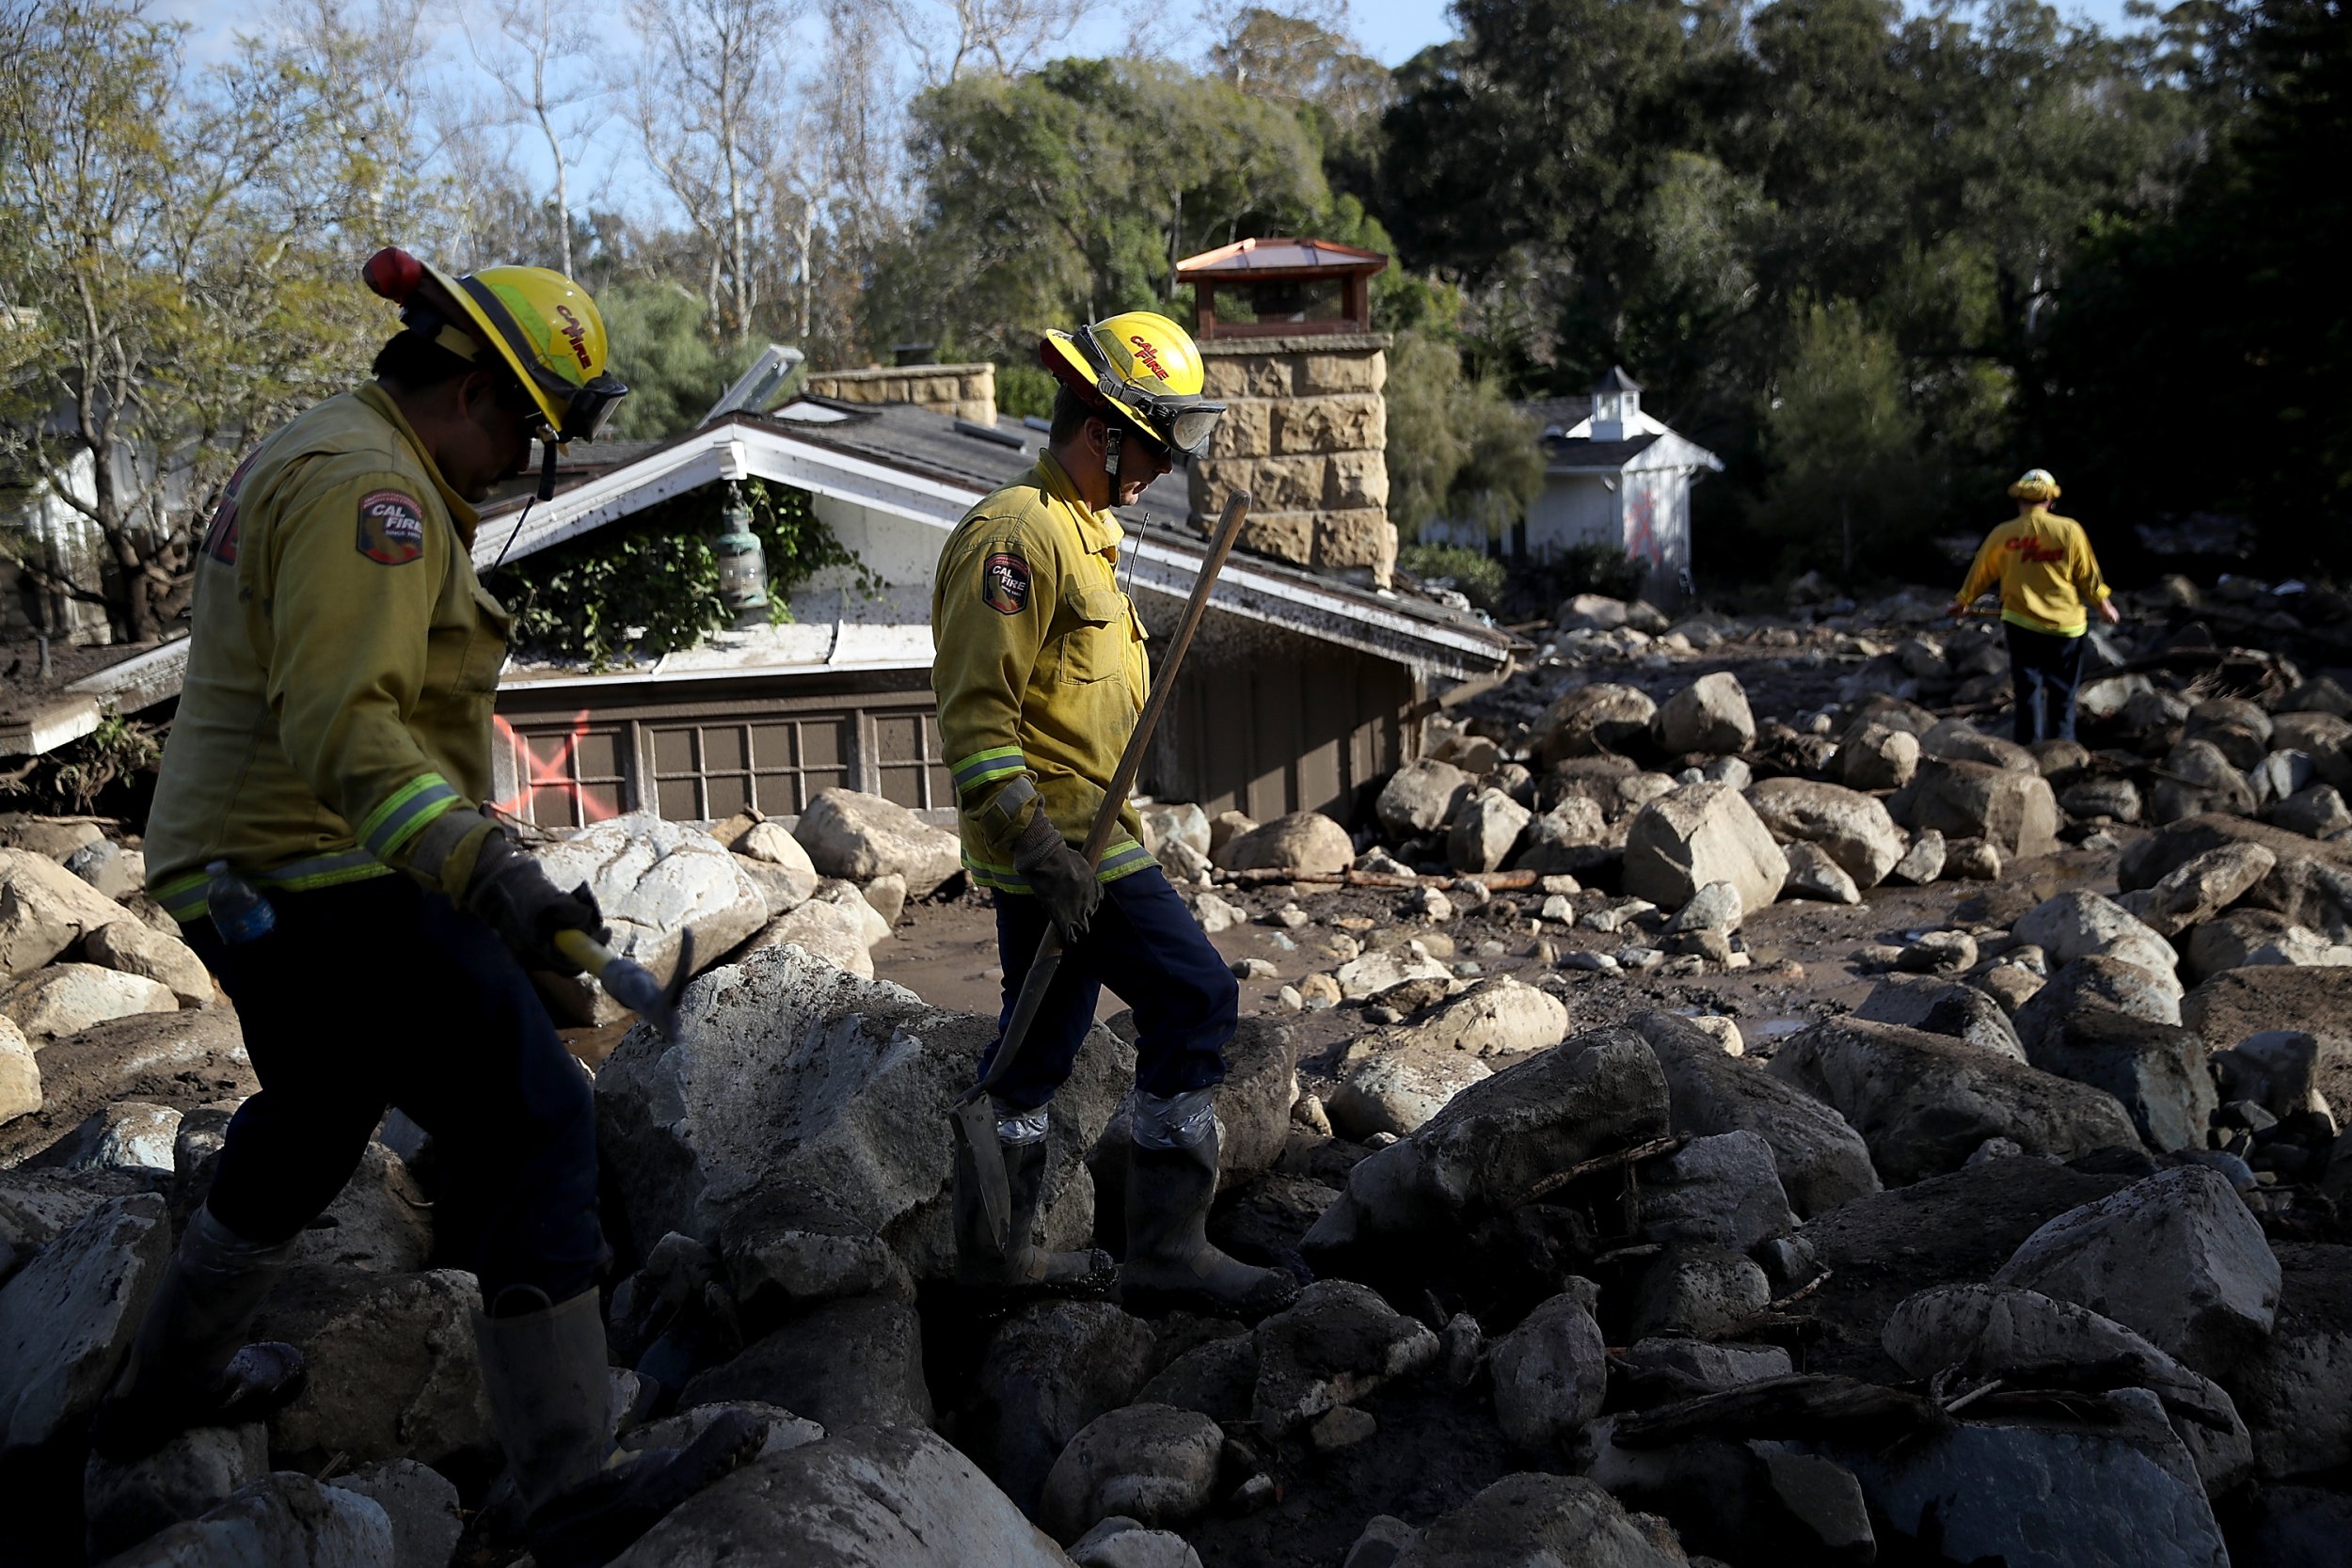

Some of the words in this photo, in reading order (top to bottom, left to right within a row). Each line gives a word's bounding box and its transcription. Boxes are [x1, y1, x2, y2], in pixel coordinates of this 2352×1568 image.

[1130, 335, 1158, 359] CAL
[1134, 349, 1169, 381] FIRE
[372, 504, 406, 517] CAL
[386, 516, 423, 534] FIRE
[993, 565, 1012, 578] CAL
[1001, 576, 1026, 592] FIRE
